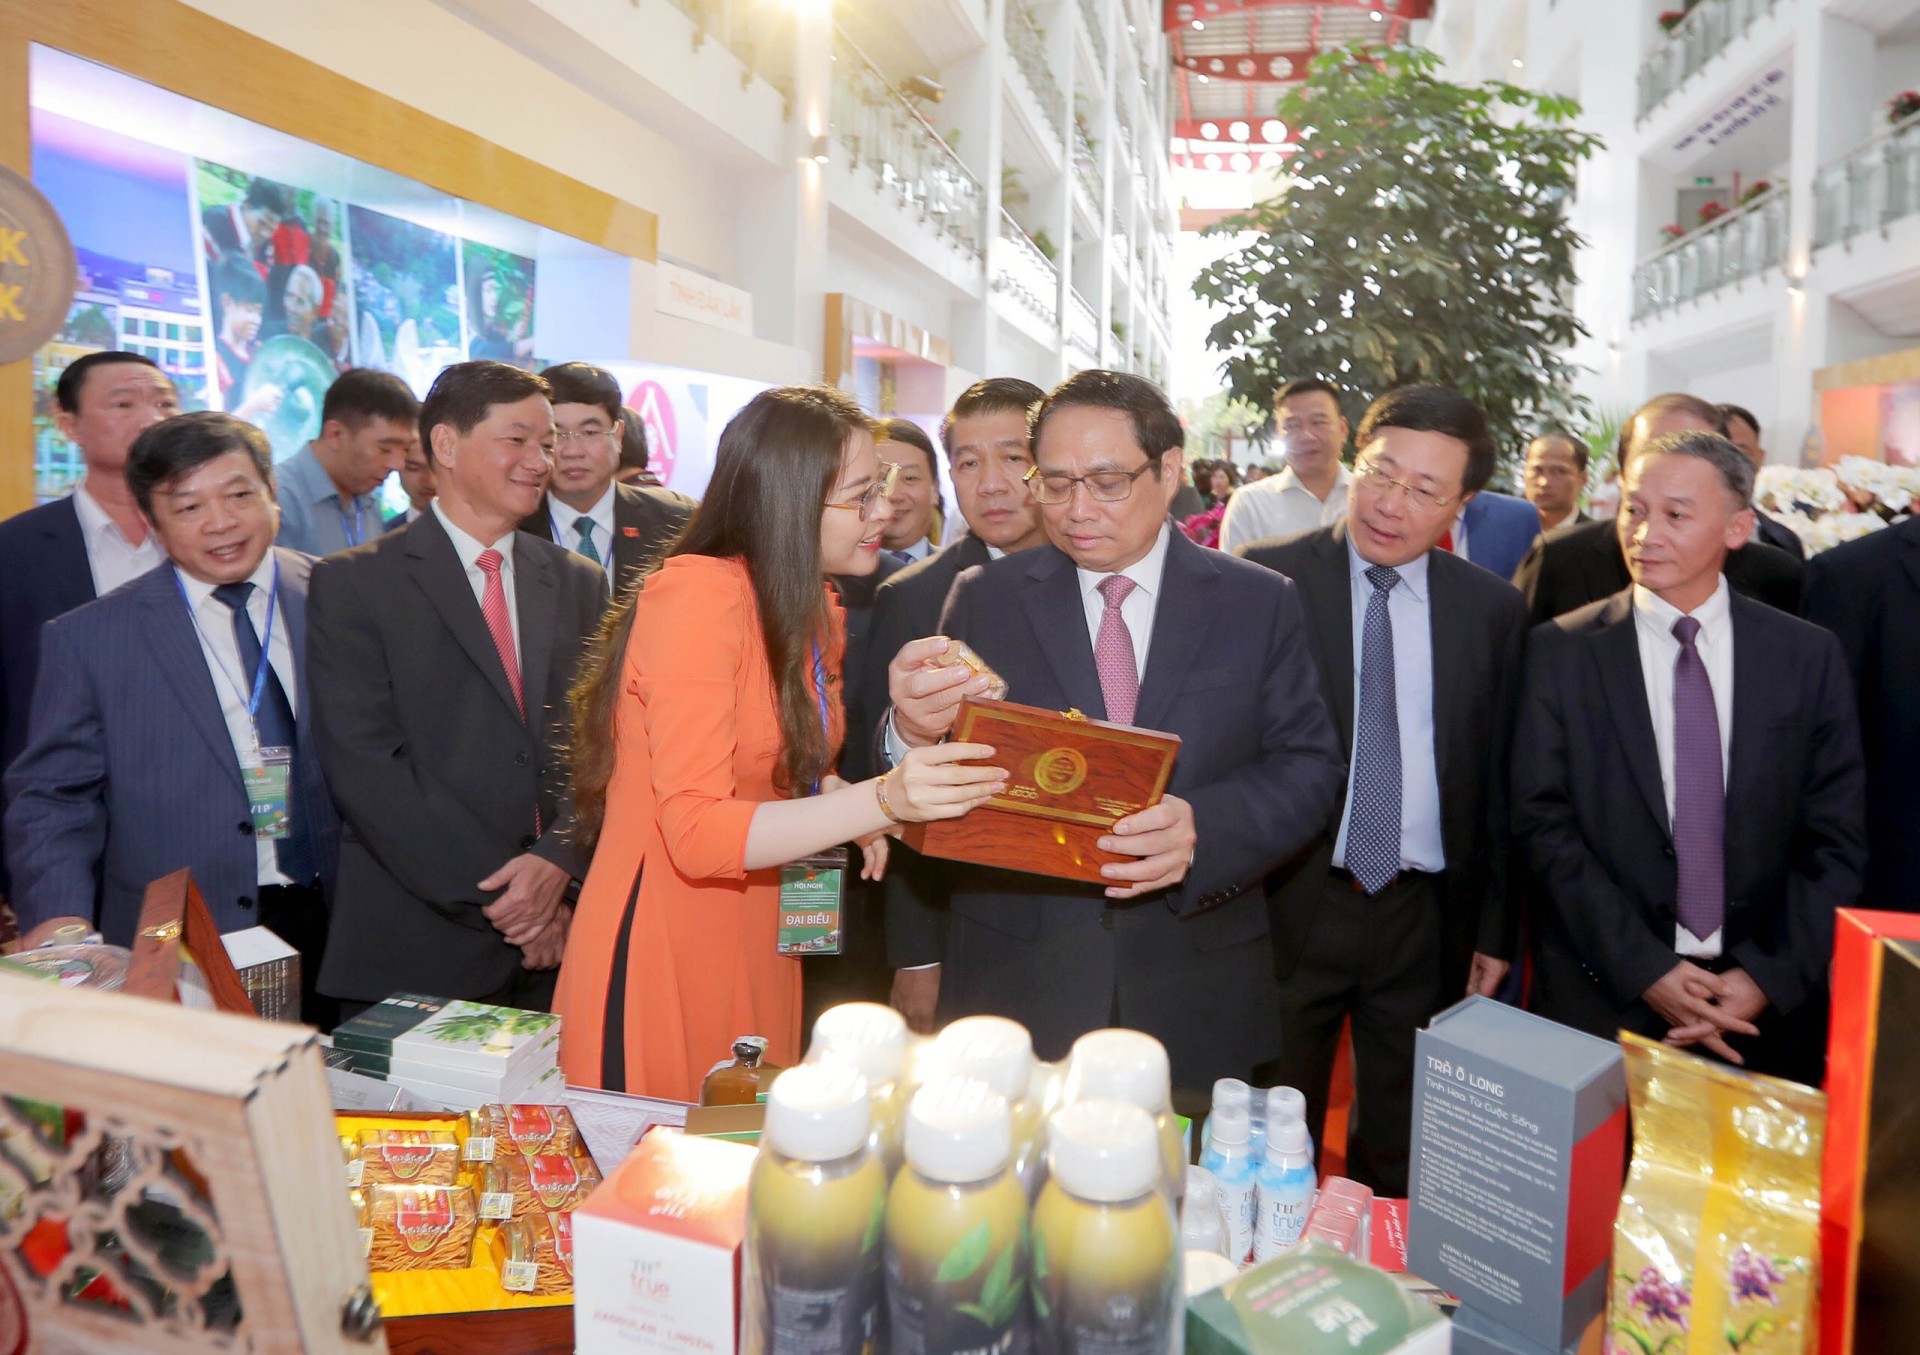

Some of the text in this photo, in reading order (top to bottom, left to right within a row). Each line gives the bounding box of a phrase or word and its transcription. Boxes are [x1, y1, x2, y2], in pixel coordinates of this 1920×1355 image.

[786, 915, 804, 927] ĐẠI
[1426, 1055, 1452, 1077] TRÀ
[1469, 1073, 1504, 1098] LONG
[1425, 1077, 1445, 1093] Tinh
[1273, 1201, 1293, 1214] TH
[1272, 1212, 1305, 1230] true
